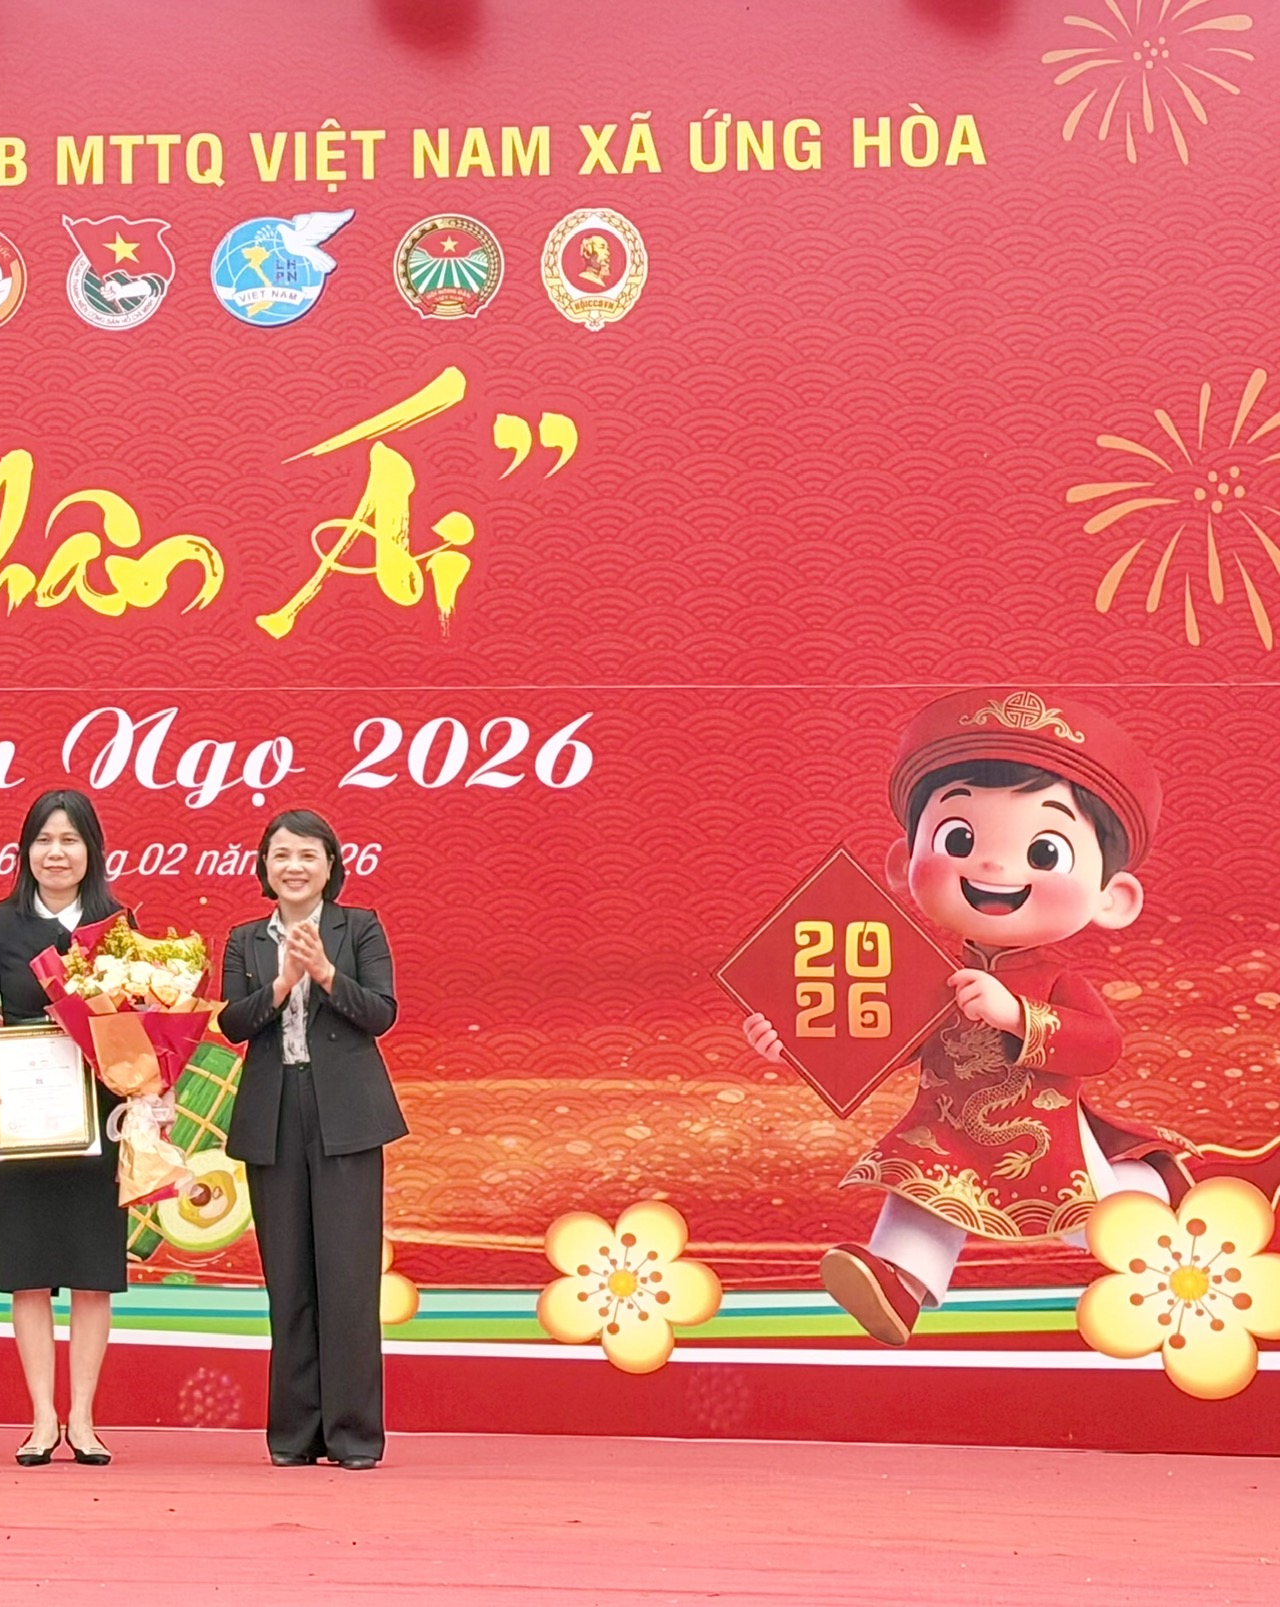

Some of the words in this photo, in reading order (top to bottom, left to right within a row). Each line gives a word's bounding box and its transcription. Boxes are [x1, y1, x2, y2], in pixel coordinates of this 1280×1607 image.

[56, 132, 225, 188] MTTQ
[249, 118, 386, 193] VIỆT
[413, 125, 550, 179] NAM
[578, 110, 662, 175] XÃ
[689, 108, 822, 173] ỨNG
[852, 102, 987, 168] HÒA
[271, 289, 298, 301] NAM
[61, 706, 306, 810] Ngọ
[338, 711, 594, 789] 2026
[137, 843, 188, 875] 02
[794, 920, 893, 978] 20
[795, 982, 893, 1038] 26
